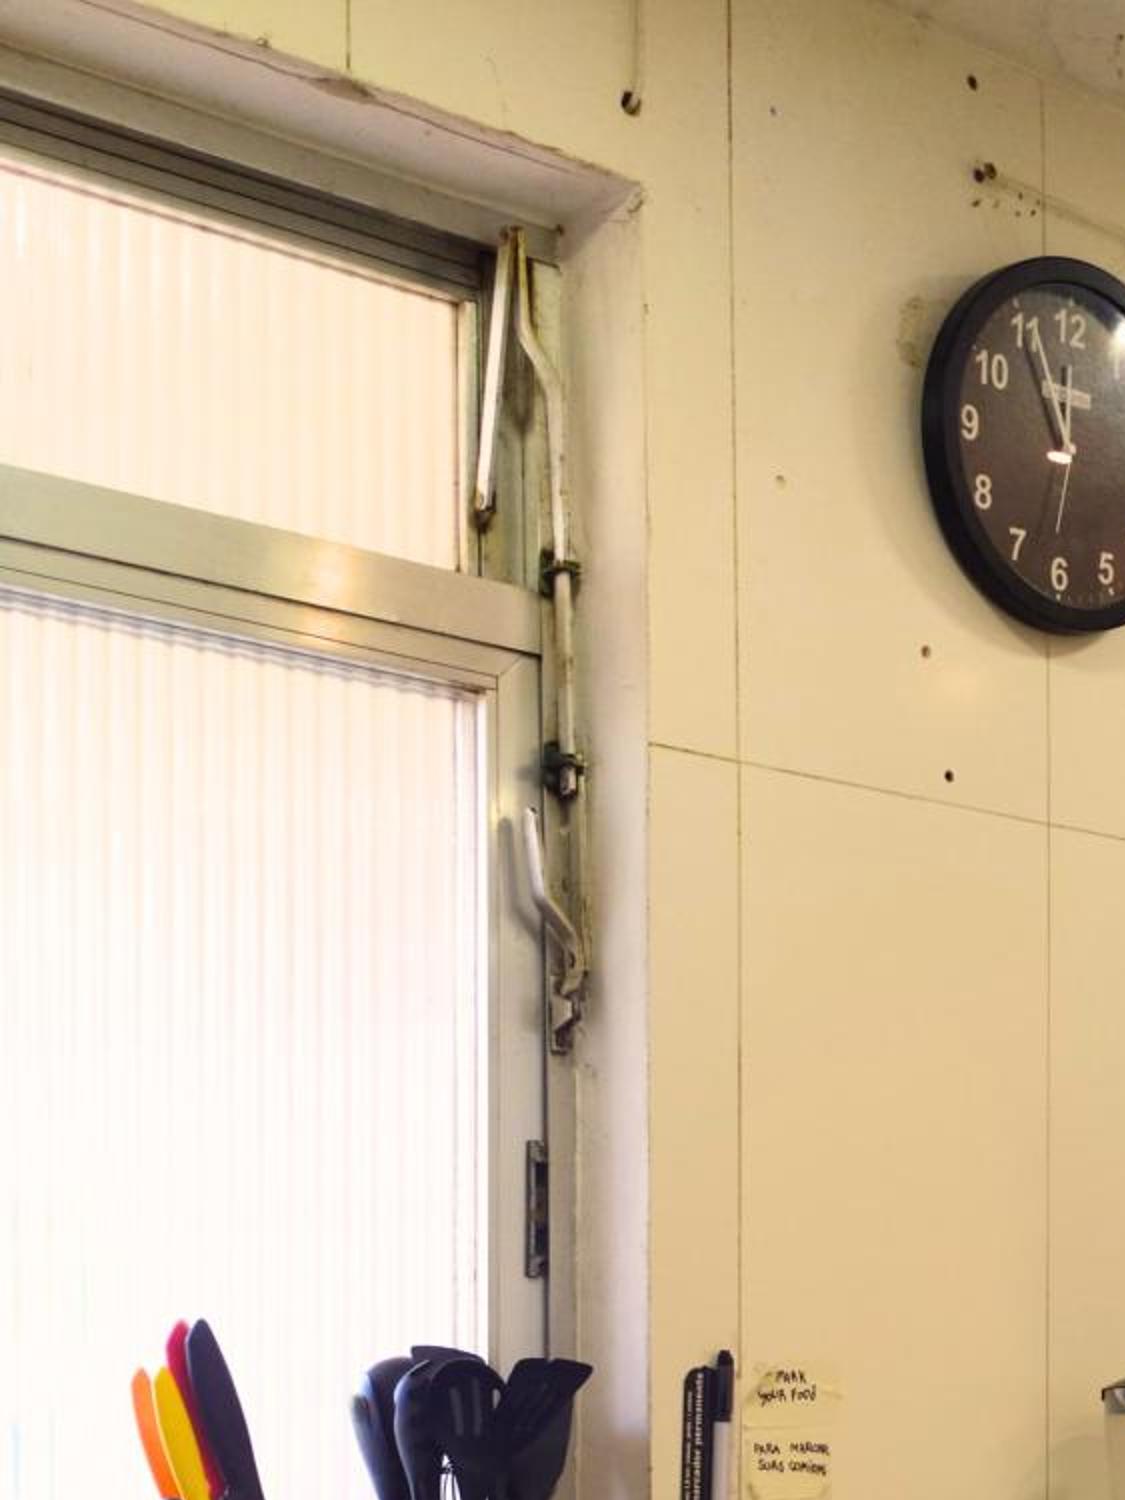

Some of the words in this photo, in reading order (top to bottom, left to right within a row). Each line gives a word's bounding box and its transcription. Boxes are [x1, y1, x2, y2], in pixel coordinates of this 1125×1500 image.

[1010, 313, 1040, 353] 11
[1054, 309, 1087, 349] 12
[975, 351, 1009, 390] 10
[961, 404, 979, 440] 9
[974, 474, 992, 509] 8
[1009, 527, 1027, 561] 7
[1050, 557, 1068, 592] 6
[1097, 552, 1114, 586] 5
[753, 1443, 780, 1454] PARA
